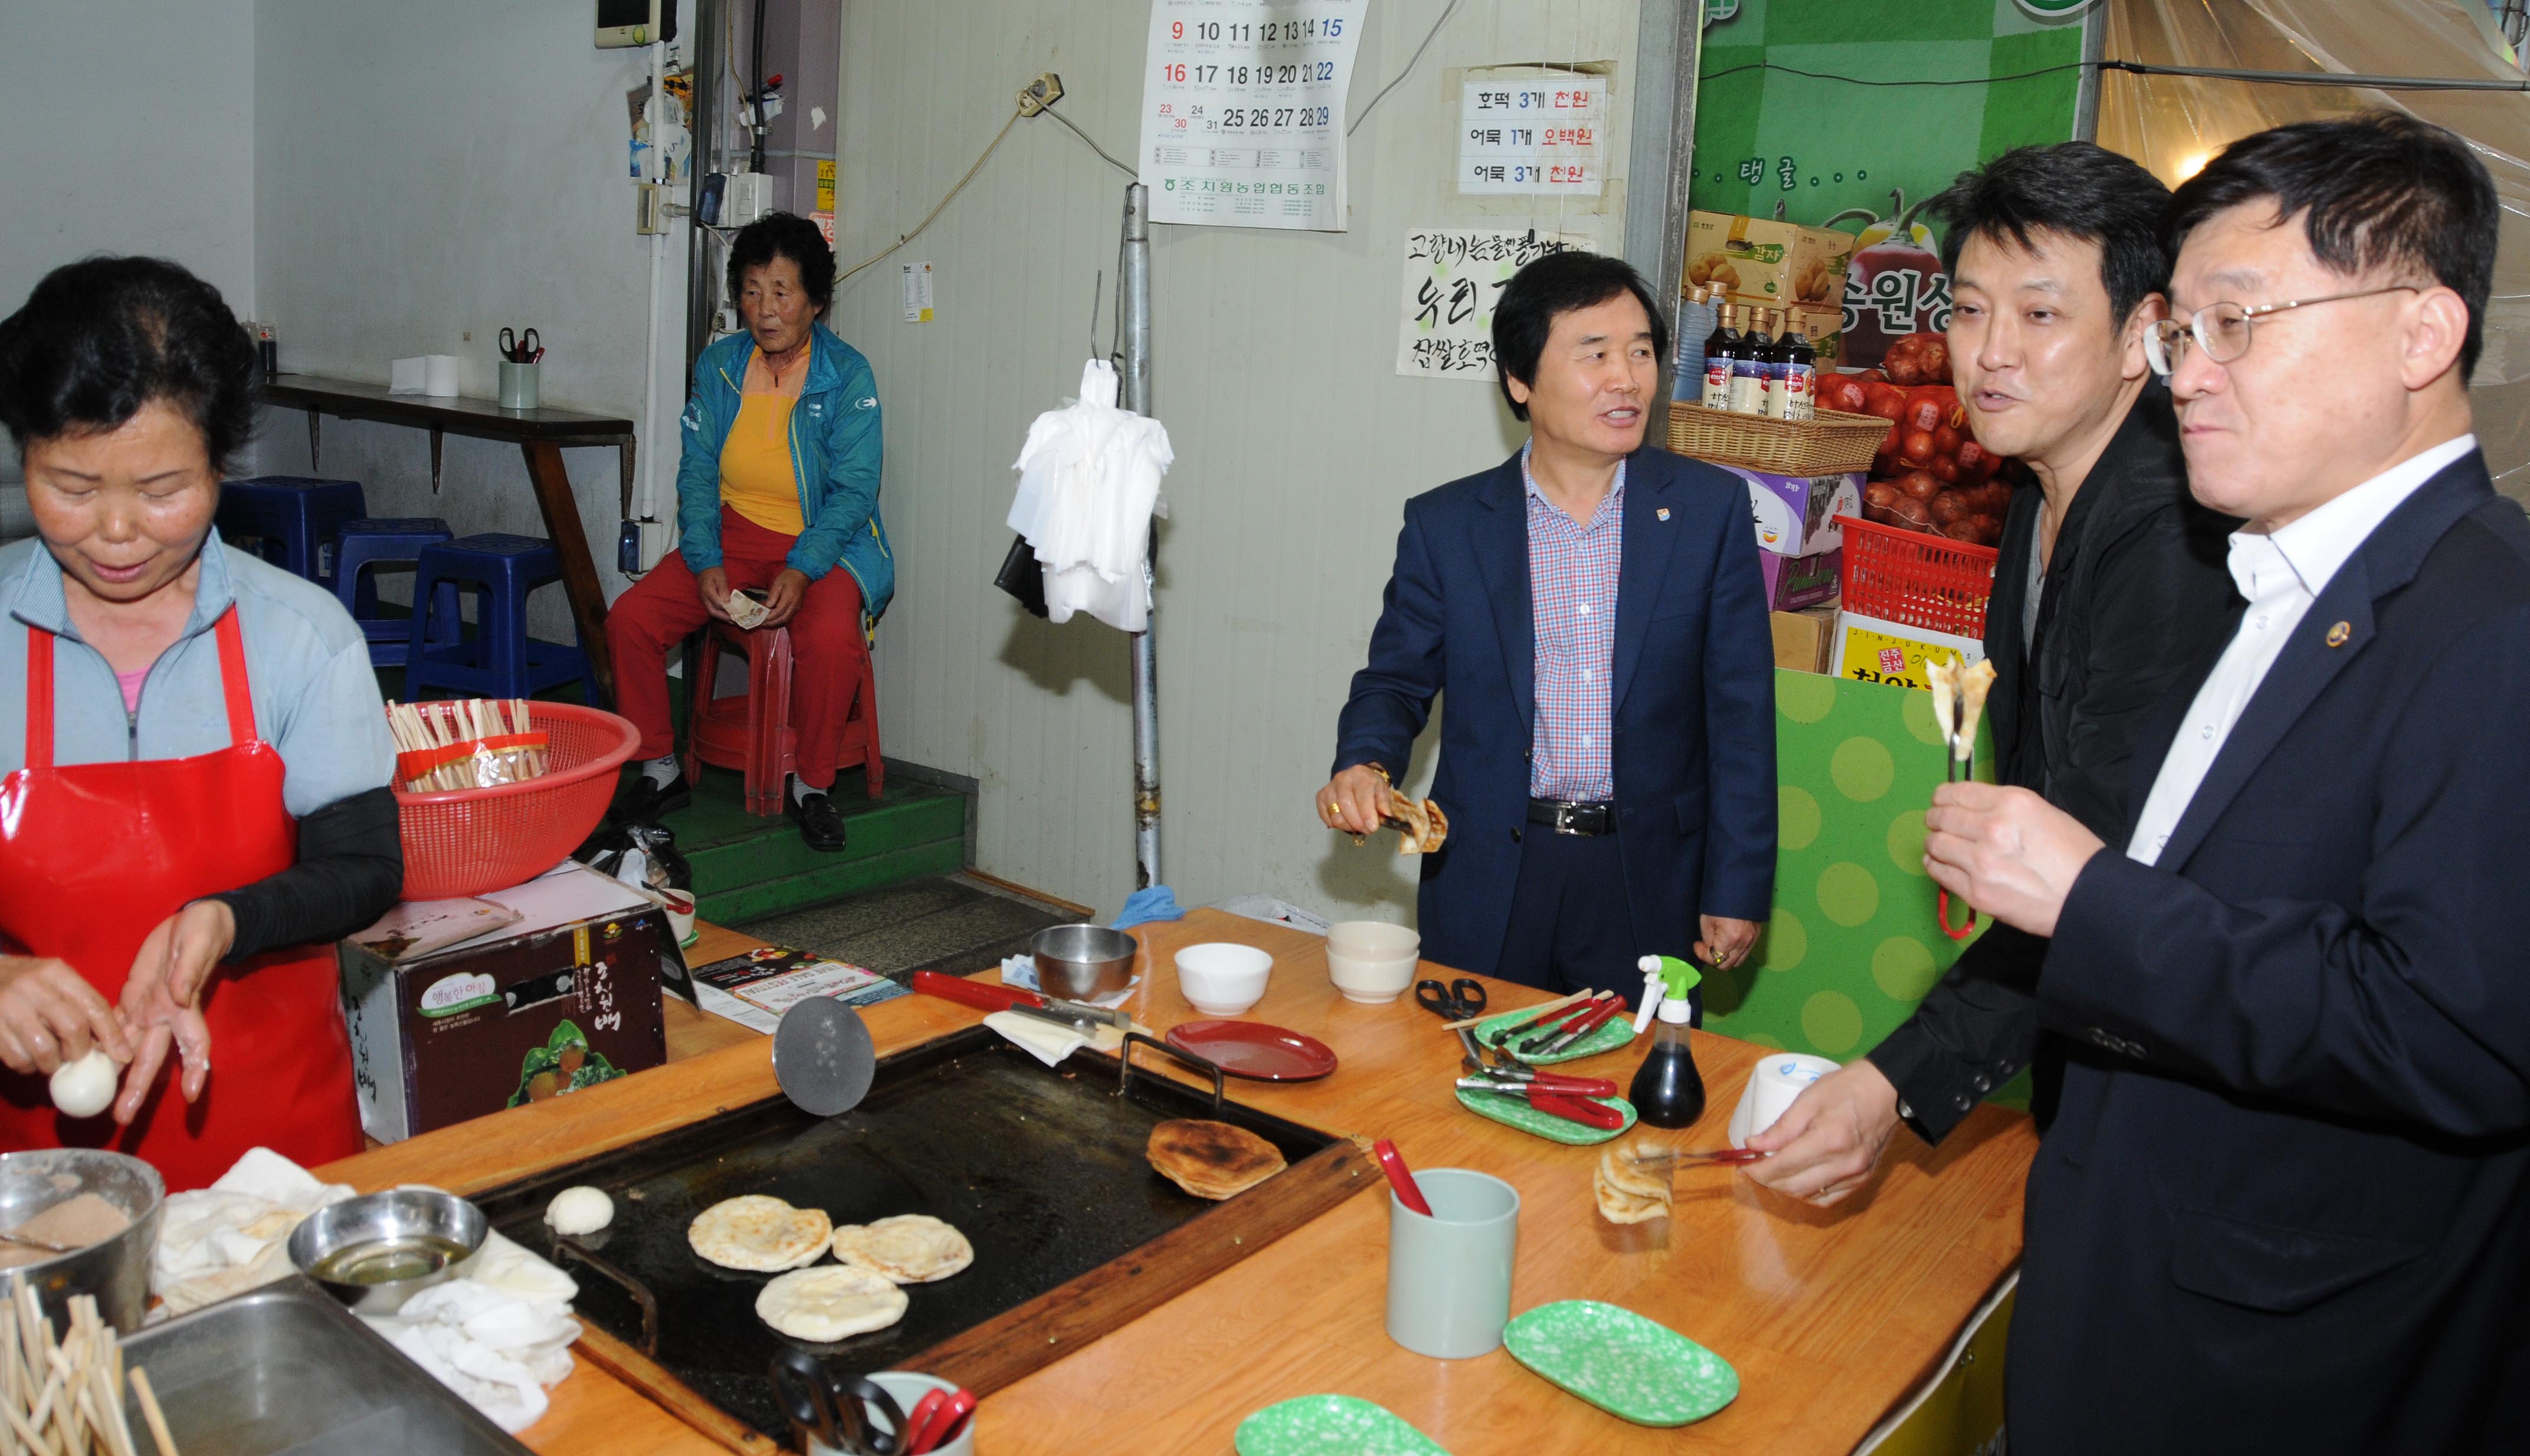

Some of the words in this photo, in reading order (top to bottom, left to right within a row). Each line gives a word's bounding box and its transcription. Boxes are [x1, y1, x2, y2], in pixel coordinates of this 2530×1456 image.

[1172, 21, 1184, 40] 9
[1198, 22, 1220, 40] 10
[1230, 23, 1250, 41] 11
[1259, 23, 1277, 41] 12
[1283, 21, 1298, 40] 13
[1302, 19, 1314, 38] 14
[1322, 18, 1343, 37] 15
[1164, 64, 1186, 82] 16
[1195, 65, 1218, 83] 17
[1227, 66, 1248, 84] 18
[1256, 65, 1273, 84] 19
[1278, 65, 1296, 83] 20
[1302, 64, 1313, 83] 21
[1317, 62, 1333, 81] 22
[1478, 92, 1510, 109] 호떡
[1519, 92, 1545, 109] 3개
[1555, 91, 1588, 108] 천원
[1160, 104, 1172, 113] 23
[1191, 105, 1204, 114] 24
[1224, 109, 1244, 127] 25
[1250, 109, 1269, 127] 26
[1274, 109, 1294, 127] 27
[1299, 107, 1314, 127] 28
[1317, 106, 1329, 126] 29
[1175, 119, 1187, 128] 30
[1207, 120, 1218, 130] 31
[1470, 129, 1501, 146] 어묵
[1511, 129, 1532, 146] 1개
[1542, 129, 1592, 146] 오백원
[1474, 166, 1505, 182] 어묵
[1515, 166, 1541, 183] 3개
[1551, 165, 1584, 183] 천원
[1754, 245, 1778, 261] 감자
[1412, 338, 1497, 372] 찹쌀호떡
[1785, 481, 1800, 493] 4kg
[1880, 649, 1901, 661] 진주
[1881, 660, 1903, 672] 금산
[789, 972, 815, 982] SALE
[432, 986, 463, 1005] 행복한
